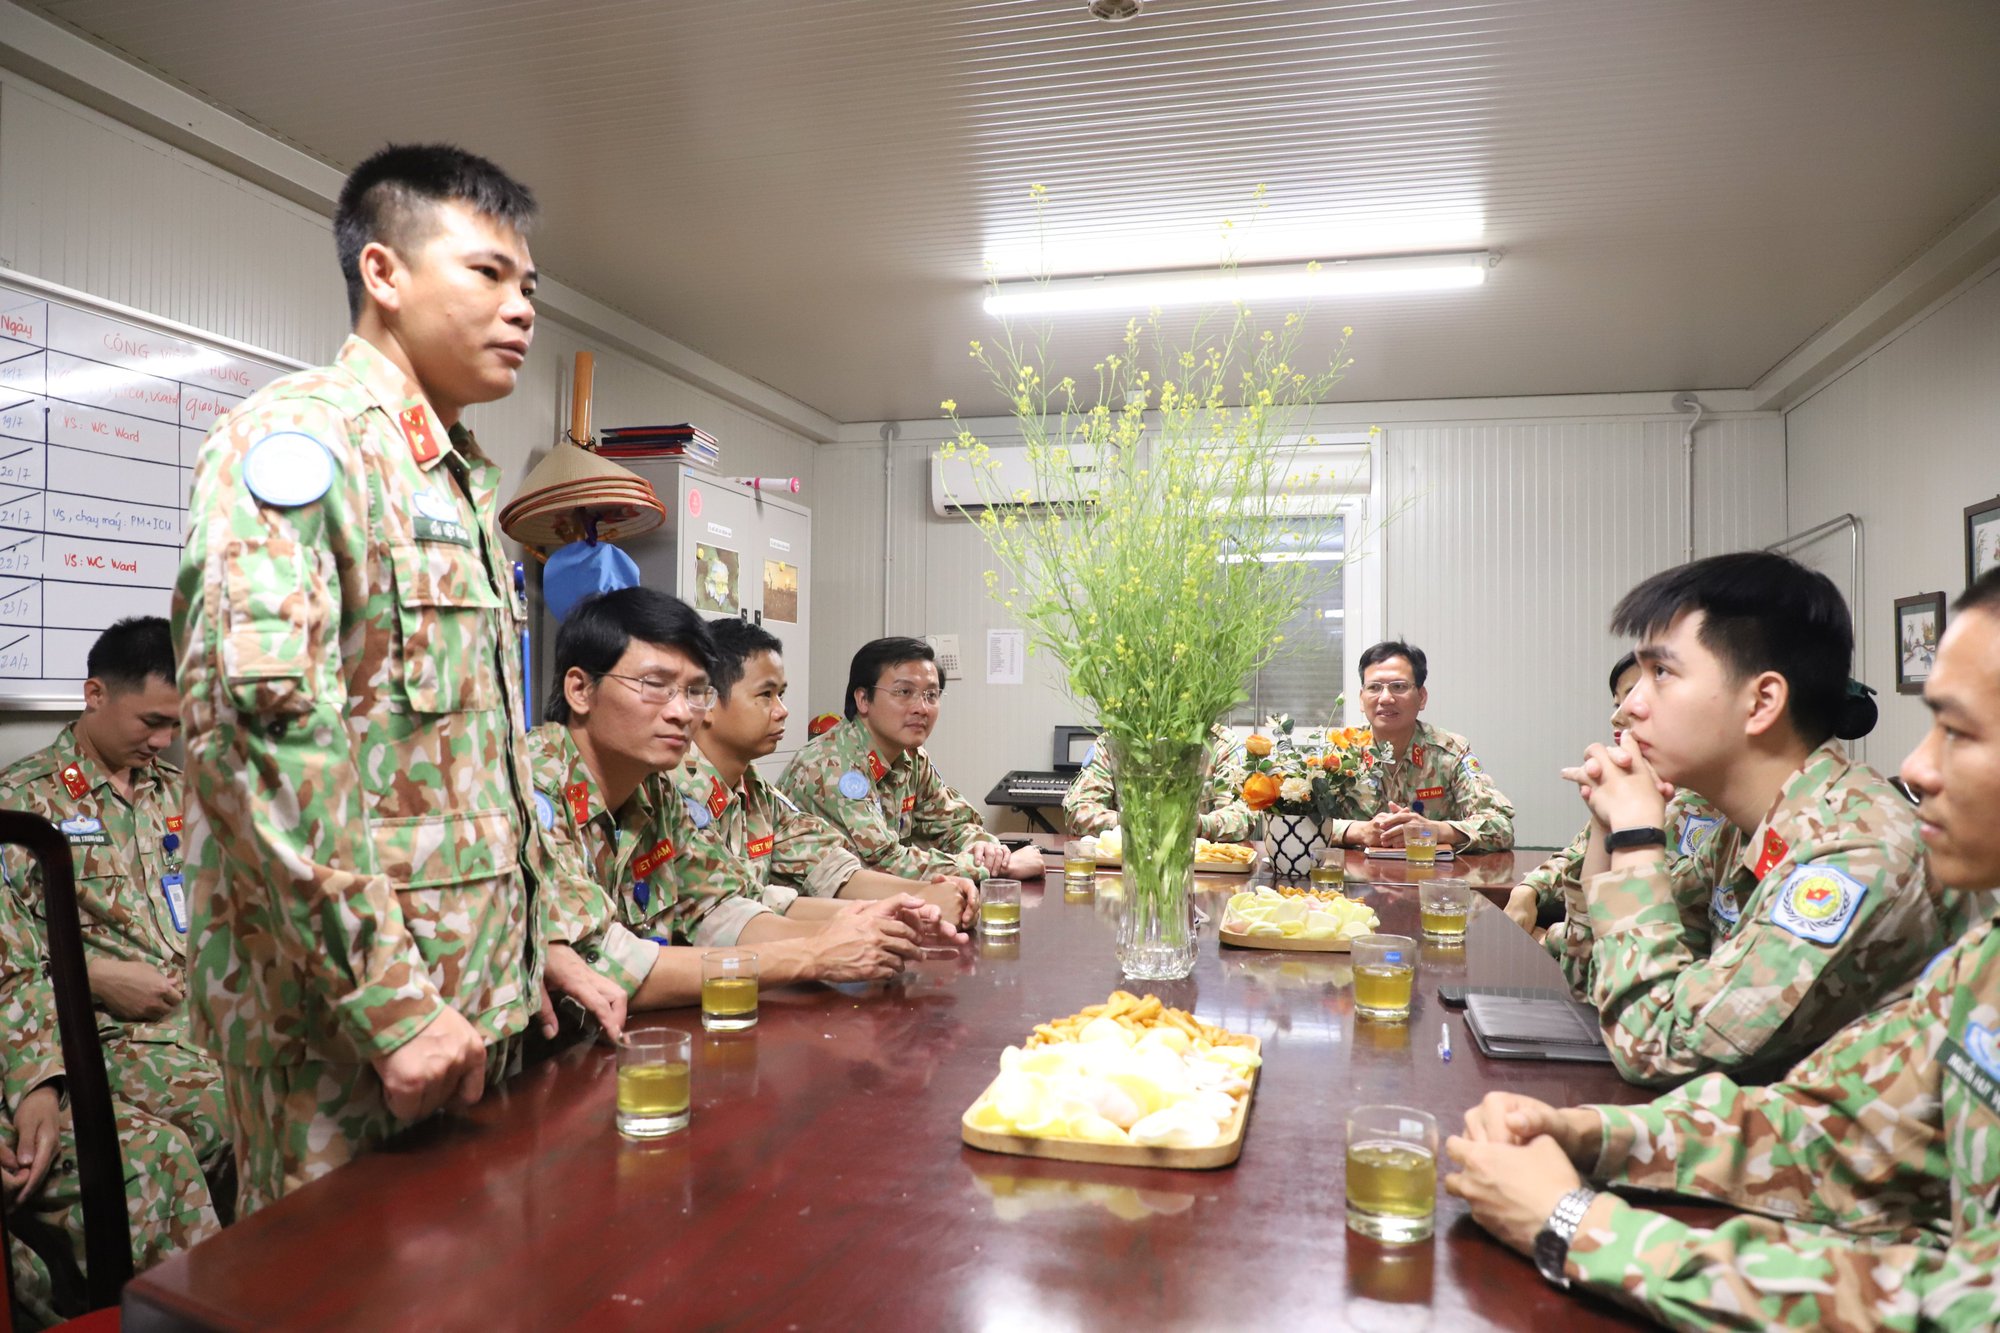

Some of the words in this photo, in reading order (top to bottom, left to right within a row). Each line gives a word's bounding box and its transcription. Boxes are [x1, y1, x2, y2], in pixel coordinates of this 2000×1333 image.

[0, 315, 32, 339] Ngày
[104, 333, 149, 359] CÔNG
[2, 414, 23, 429] 19/7
[91, 421, 109, 436] WC
[115, 426, 140, 443] Ward
[0, 508, 32, 525] 21/7
[64, 553, 84, 568] VS:
[86, 556, 106, 569] WC
[111, 557, 137, 574] Ward
[3, 599, 29, 617] 23/7
